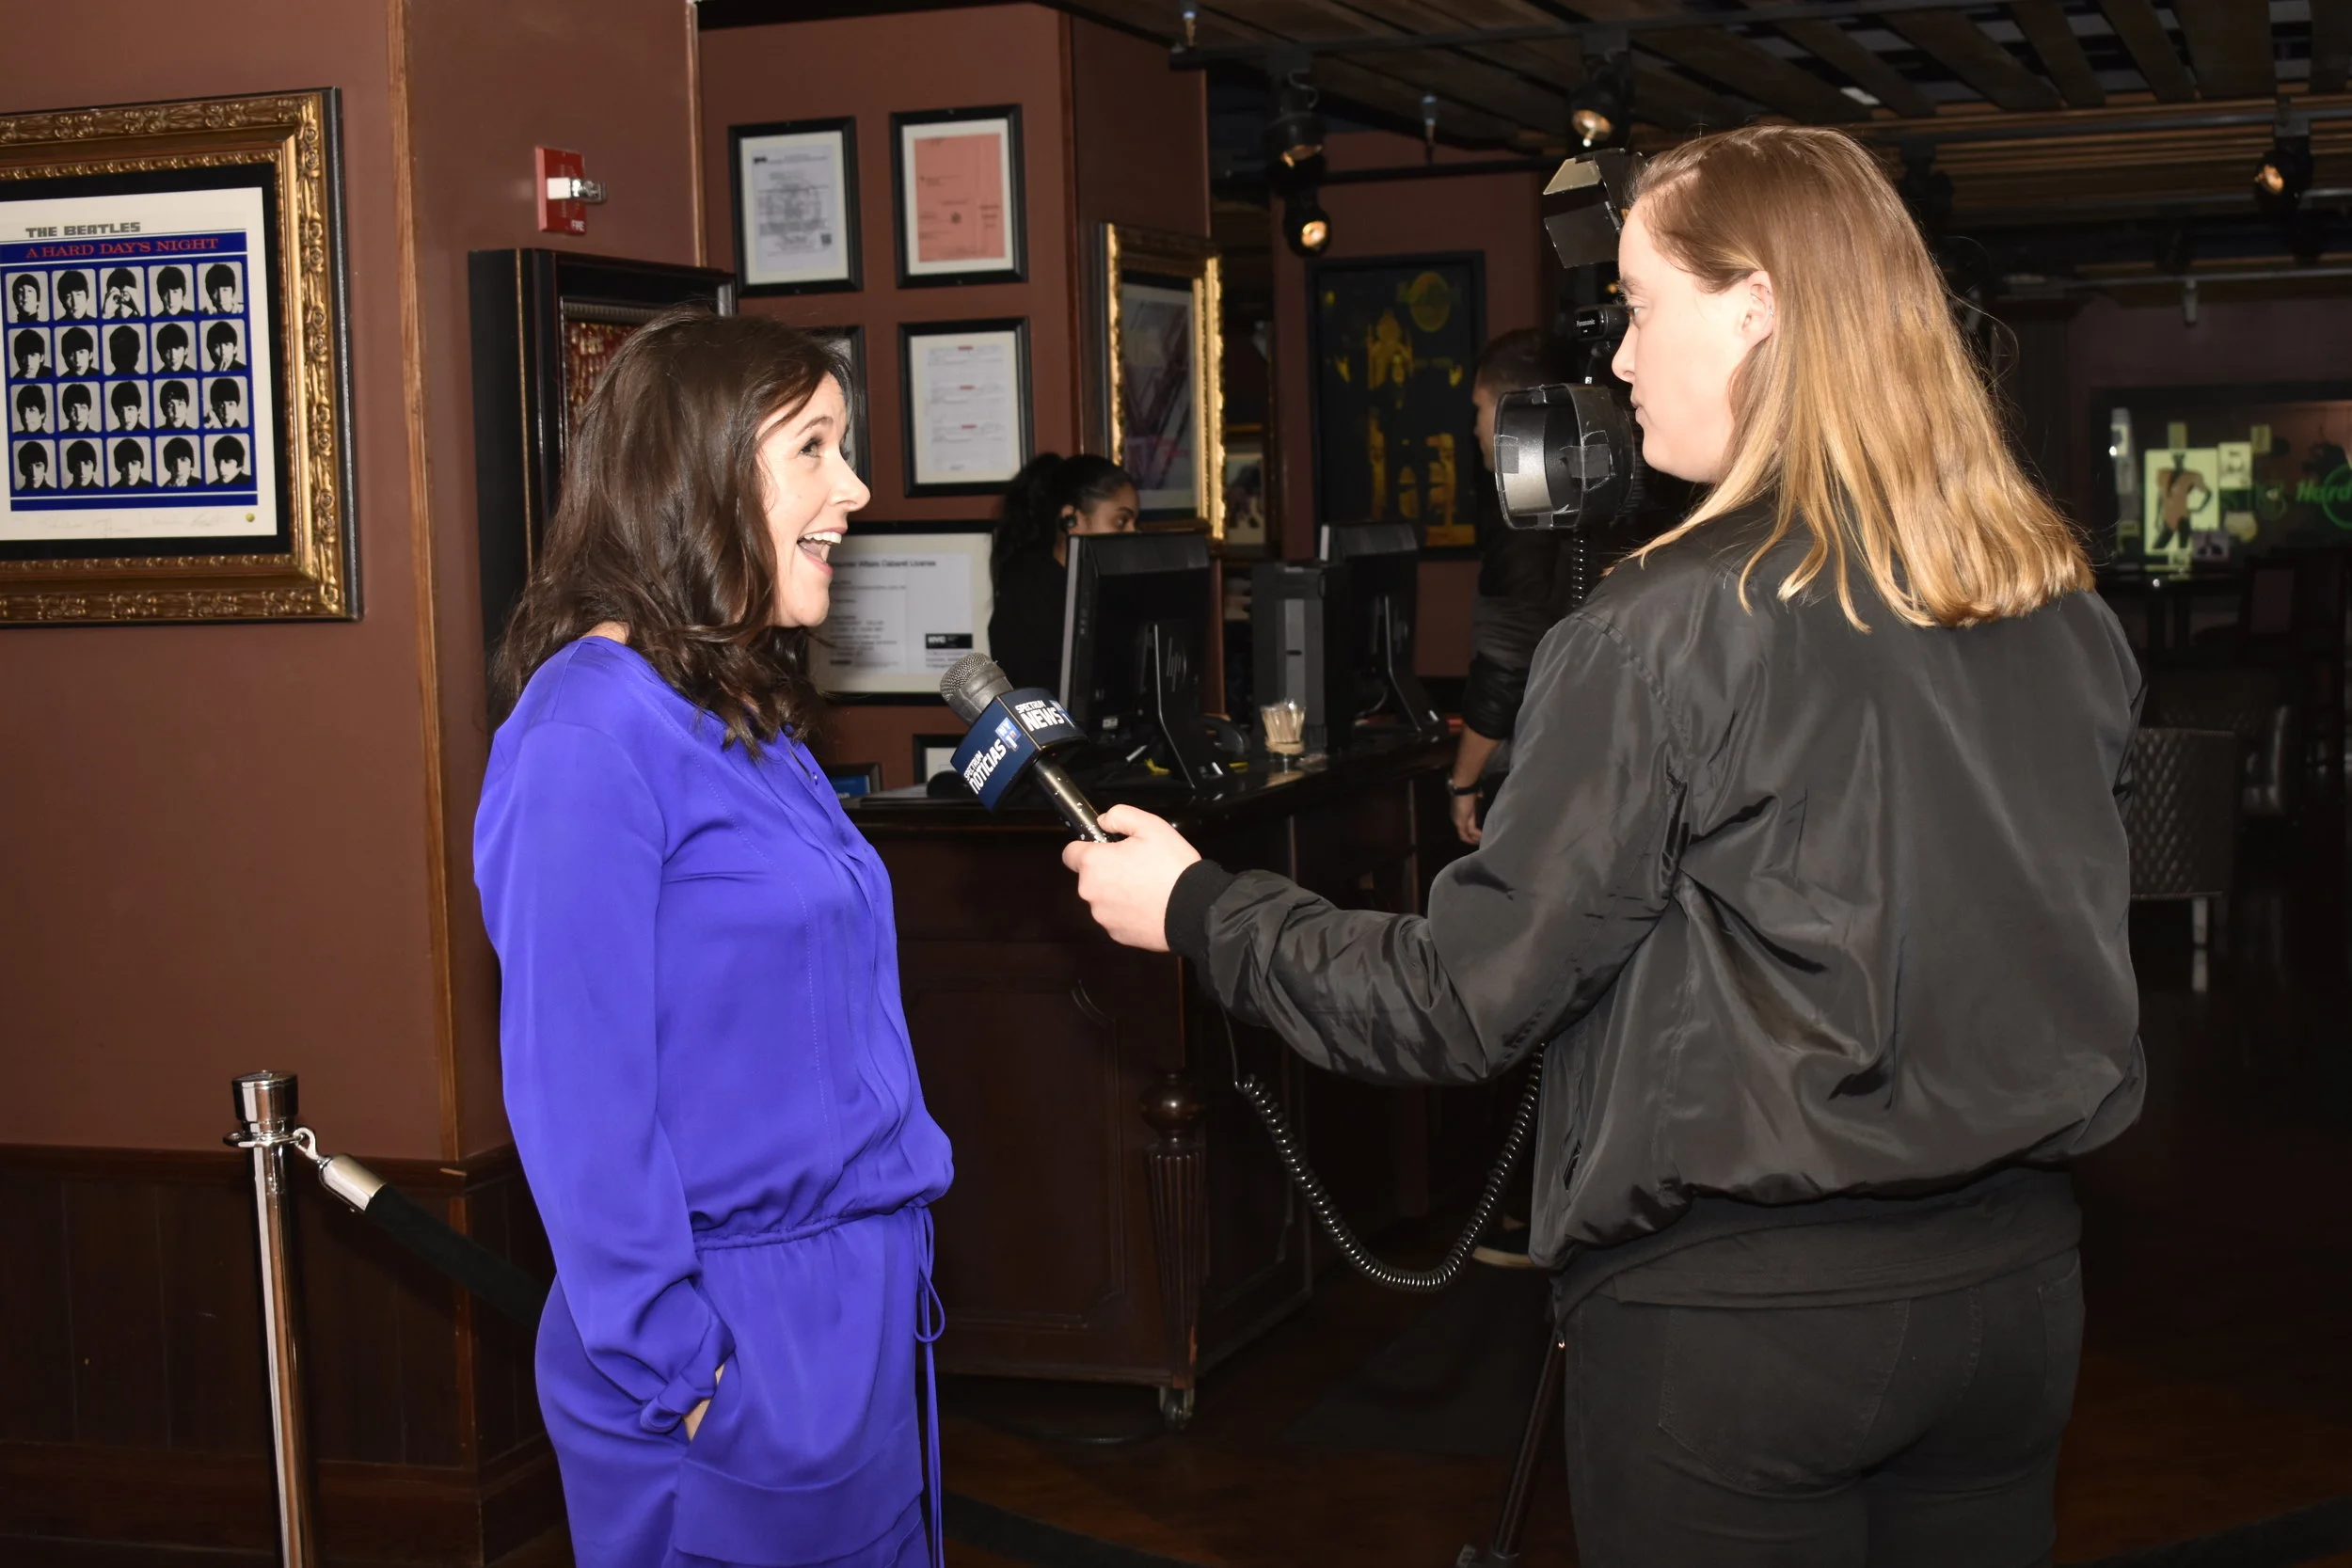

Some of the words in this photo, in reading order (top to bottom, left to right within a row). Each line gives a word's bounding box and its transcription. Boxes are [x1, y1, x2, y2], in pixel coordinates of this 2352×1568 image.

[25, 227, 57, 239] THE
[64, 222, 141, 236] BEATLES
[26, 247, 39, 259] A
[41, 244, 94, 258] HARD
[100, 240, 151, 254] DAY'S
[155, 238, 218, 252] NIGHT
[1015, 700, 1046, 714] SPECTRUM
[1020, 707, 1065, 732] NEWS
[963, 750, 984, 782] SPECTRUM
[969, 738, 1007, 796] NOTICIAS
